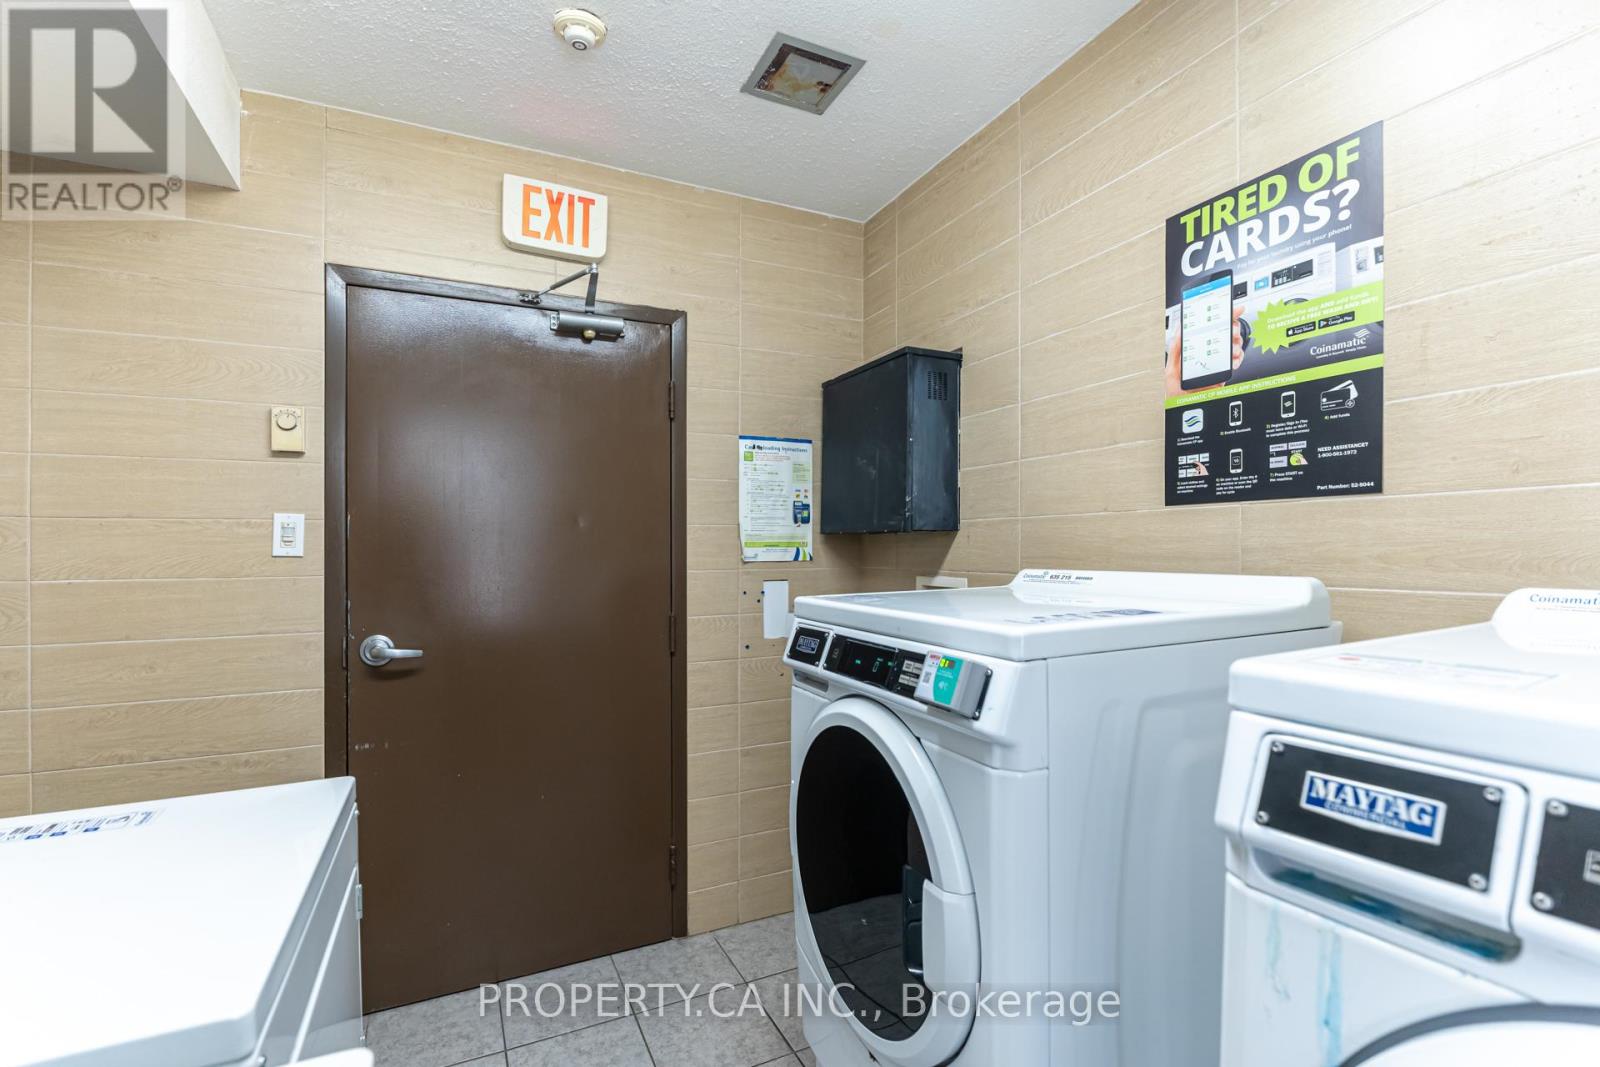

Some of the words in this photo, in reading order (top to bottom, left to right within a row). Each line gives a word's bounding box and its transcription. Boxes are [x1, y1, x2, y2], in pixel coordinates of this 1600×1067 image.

[1180, 174, 1287, 244] TIRED
[1298, 137, 1360, 192] OF
[522, 184, 595, 248] EXIT
[1181, 179, 1360, 277] CARDS?
[1328, 223, 1352, 238] phone!
[1311, 337, 1366, 355] Coinamatic
[1332, 442, 1368, 450] ASSISTANCE?
[1530, 593, 1600, 605] Coinamat
[1310, 778, 1433, 827] MAYTAG
